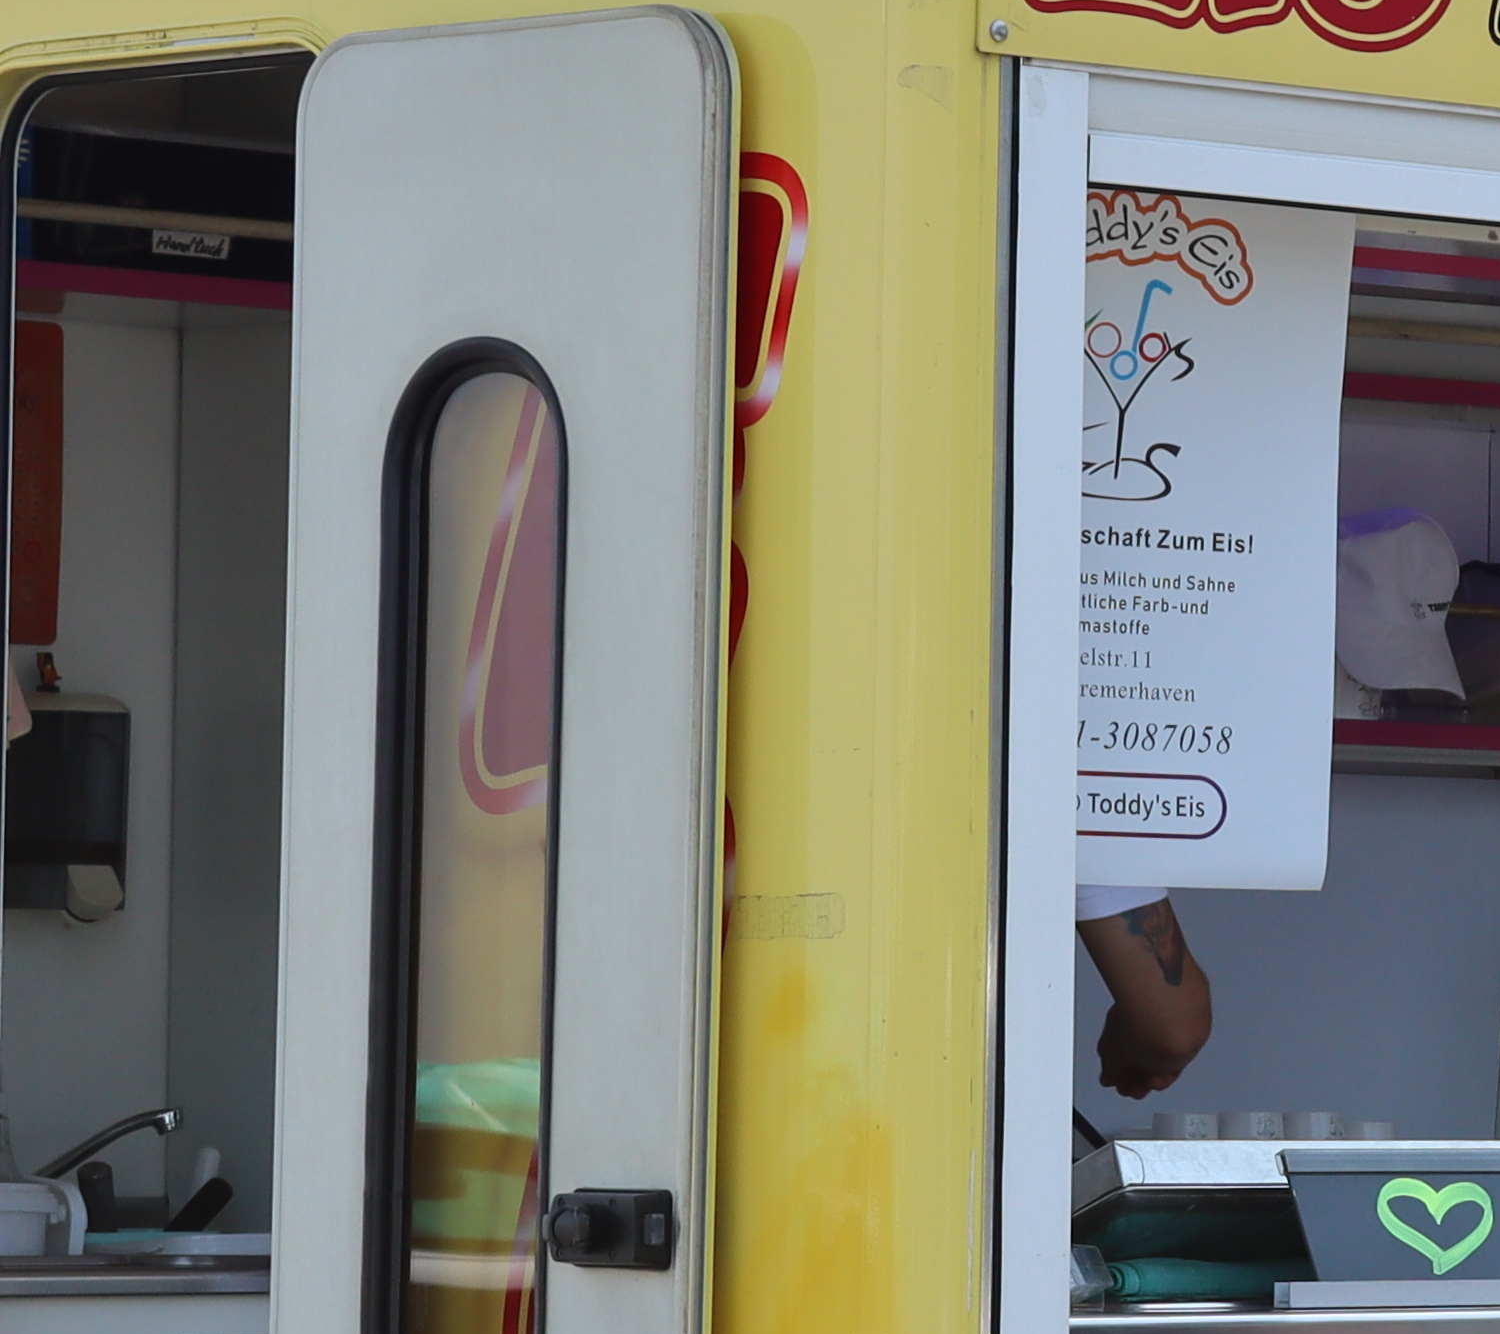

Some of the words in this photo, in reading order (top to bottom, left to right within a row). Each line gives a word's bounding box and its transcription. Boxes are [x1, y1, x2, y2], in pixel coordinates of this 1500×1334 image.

[1188, 234, 1240, 290] Eis
[1156, 529, 1205, 552] Zum
[1212, 532, 1254, 555] Eis!
[1103, 571, 1147, 588] Milch
[1152, 574, 1182, 590] und
[1186, 576, 1236, 593] Sahne
[1132, 596, 1209, 615] Farb-und
[1087, 792, 1172, 822] Toddy's
[1176, 796, 1205, 817] Eis
